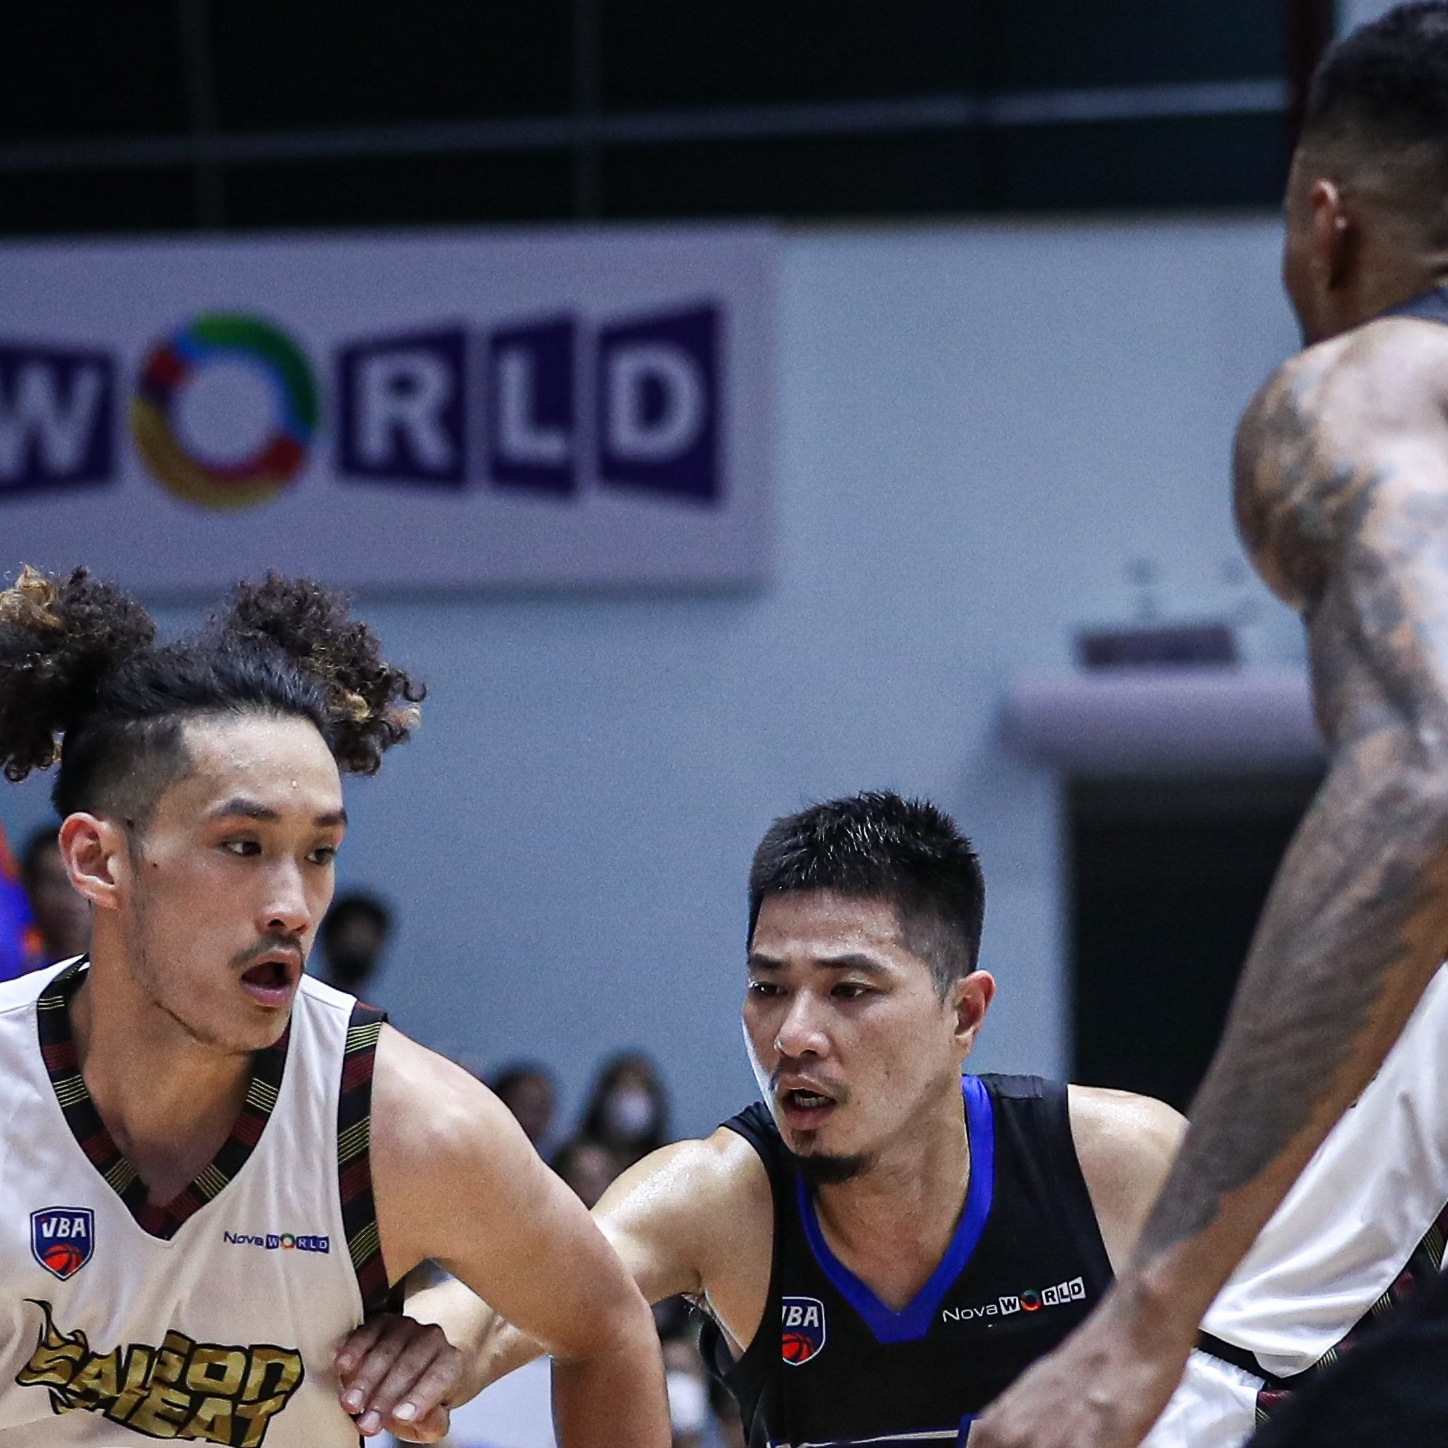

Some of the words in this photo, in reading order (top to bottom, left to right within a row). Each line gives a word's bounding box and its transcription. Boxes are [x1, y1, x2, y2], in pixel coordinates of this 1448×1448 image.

[40, 1216, 87, 1240] VBA
[223, 1230, 330, 1254] NovaWORLD
[942, 1277, 1086, 1322] NovaWORLD
[781, 1305, 820, 1328] BA
